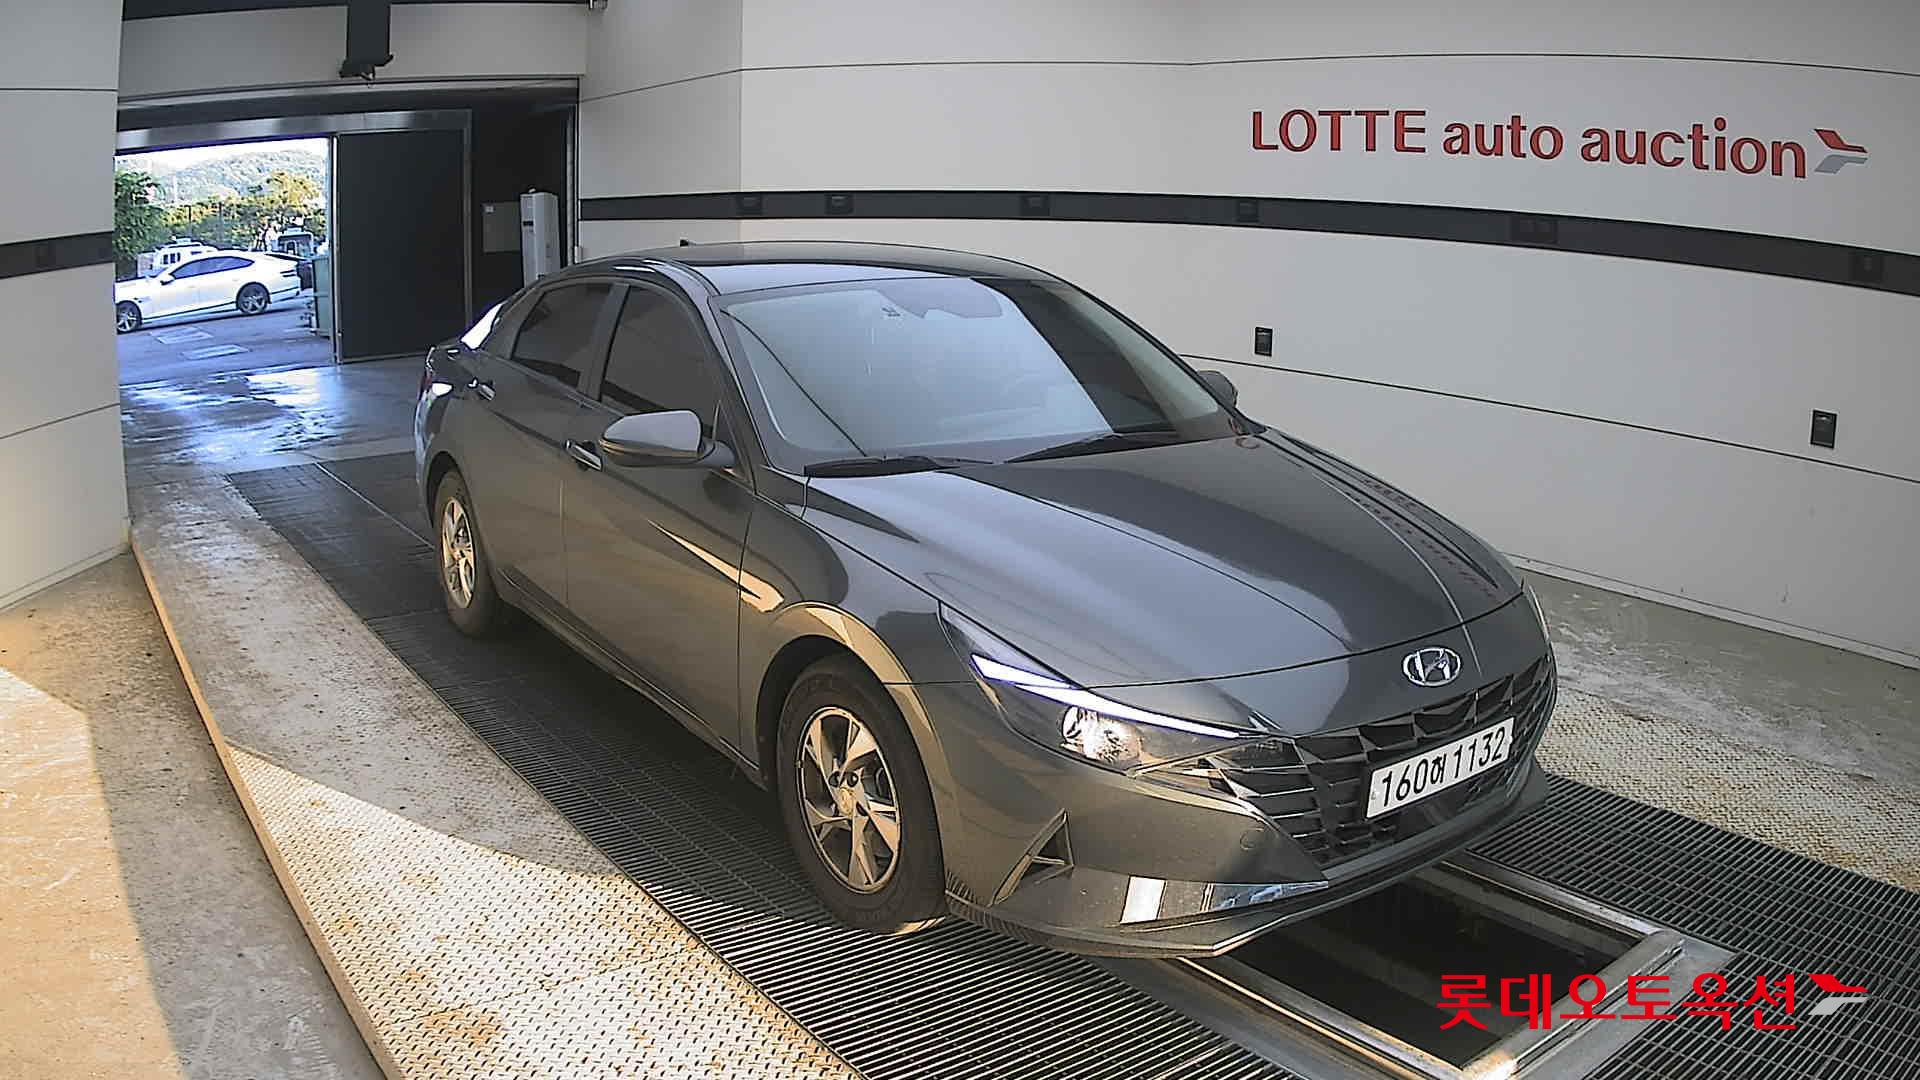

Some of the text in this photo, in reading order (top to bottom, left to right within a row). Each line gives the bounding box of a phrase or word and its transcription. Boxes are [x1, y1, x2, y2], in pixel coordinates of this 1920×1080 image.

[1251, 109, 1808, 179] LOTTE auto auction
